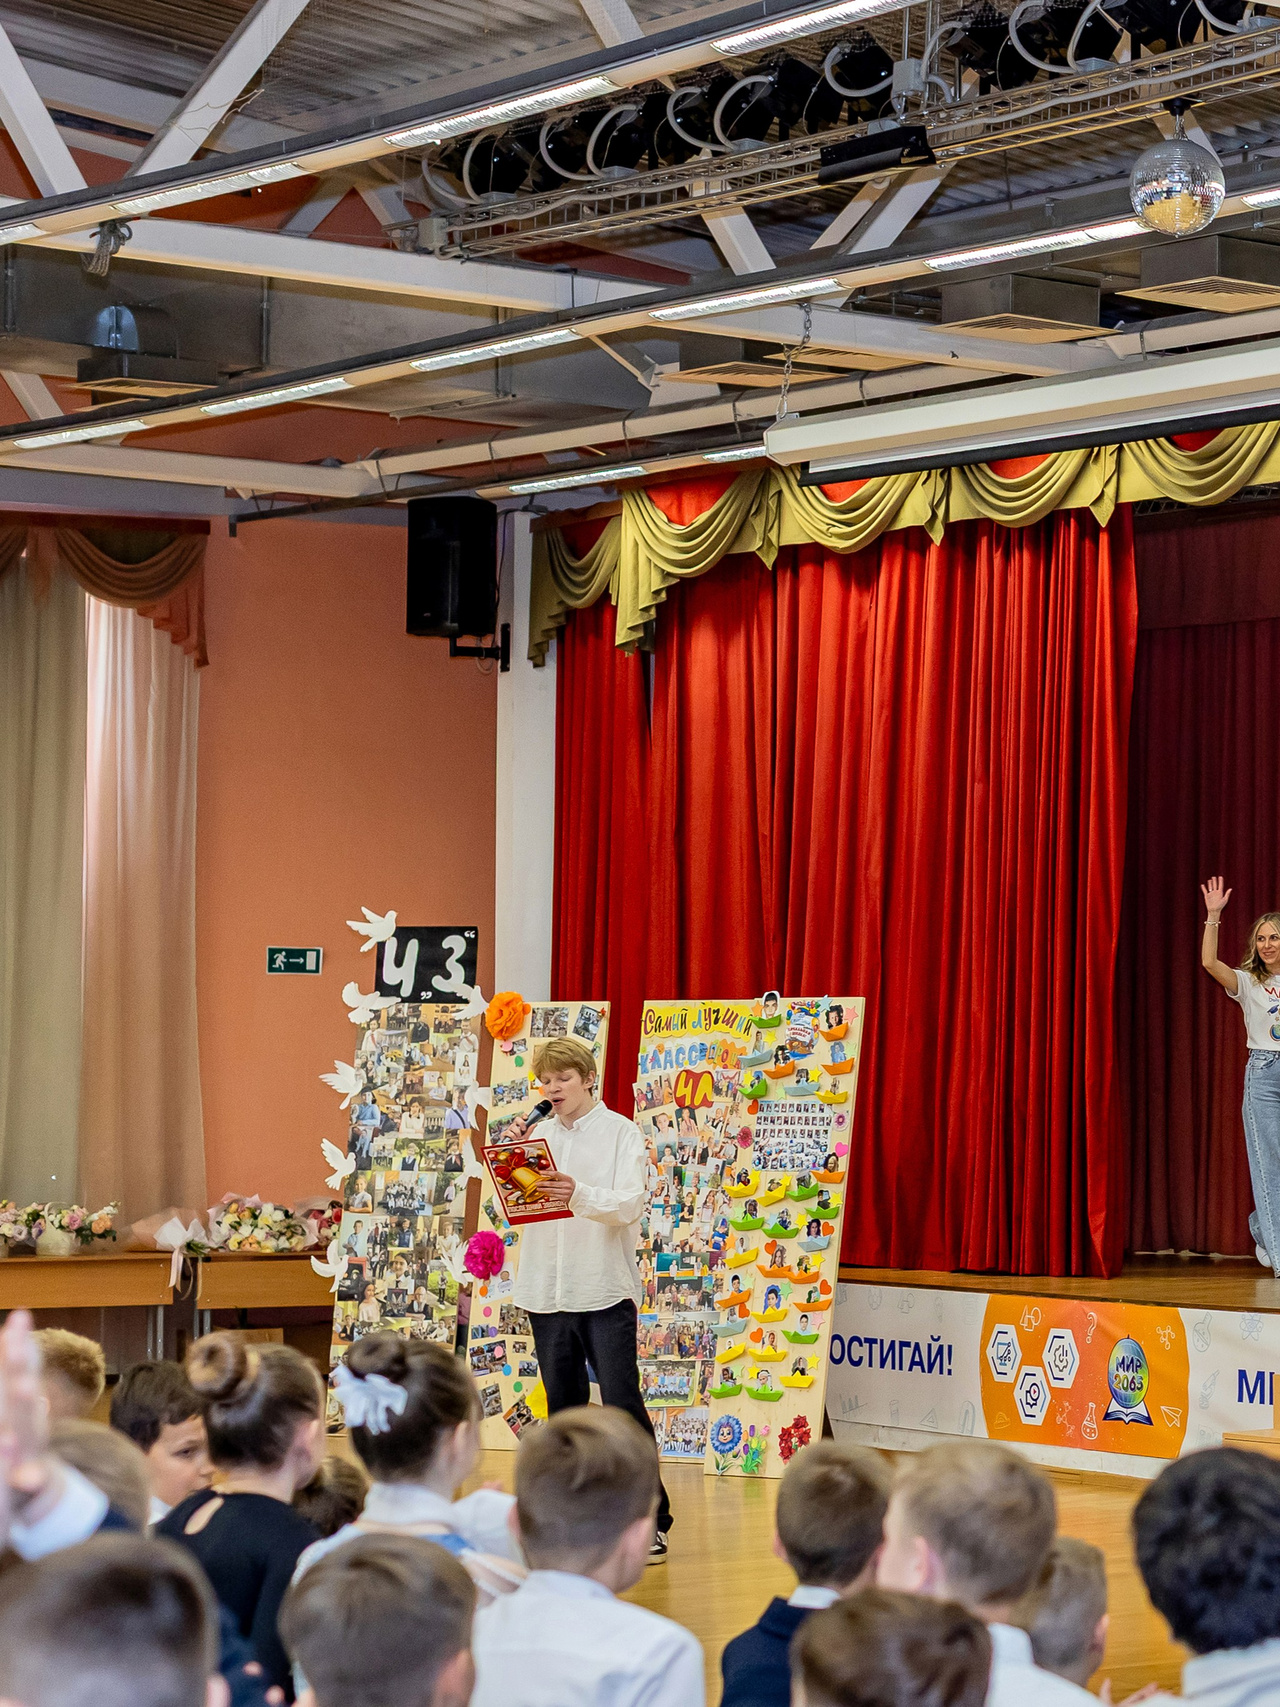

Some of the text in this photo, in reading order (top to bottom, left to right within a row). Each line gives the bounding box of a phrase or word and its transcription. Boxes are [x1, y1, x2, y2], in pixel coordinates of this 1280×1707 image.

[643, 1008, 689, 1036] Самый
[640, 1044, 699, 1075] КЛАСС
[829, 1333, 953, 1376] ОСТИГАЙ!
[1115, 1355, 1142, 1374] МИР
[1113, 1373, 1144, 1393] 2065
[1237, 1368, 1275, 1406] М
